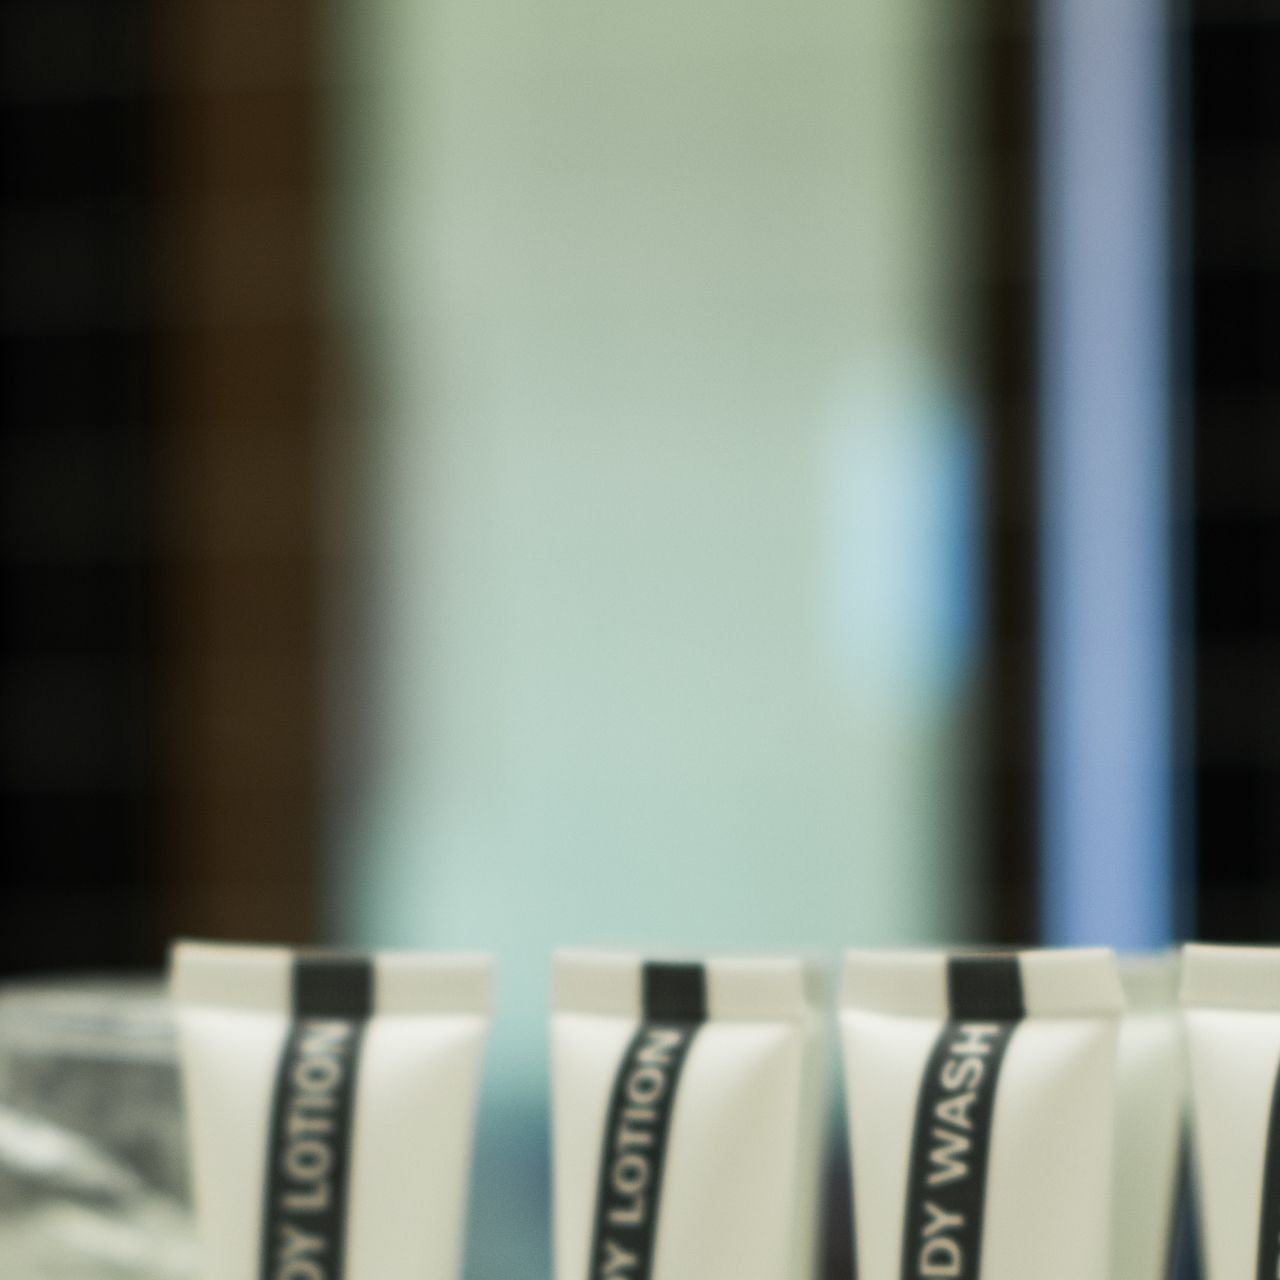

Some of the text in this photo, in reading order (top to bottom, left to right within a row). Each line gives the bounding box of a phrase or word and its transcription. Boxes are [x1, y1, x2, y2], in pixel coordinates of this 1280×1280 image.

[283, 1020, 351, 1212] LOTION
[608, 1027, 684, 1226] LOTION
[928, 1020, 1001, 1187] WASH
